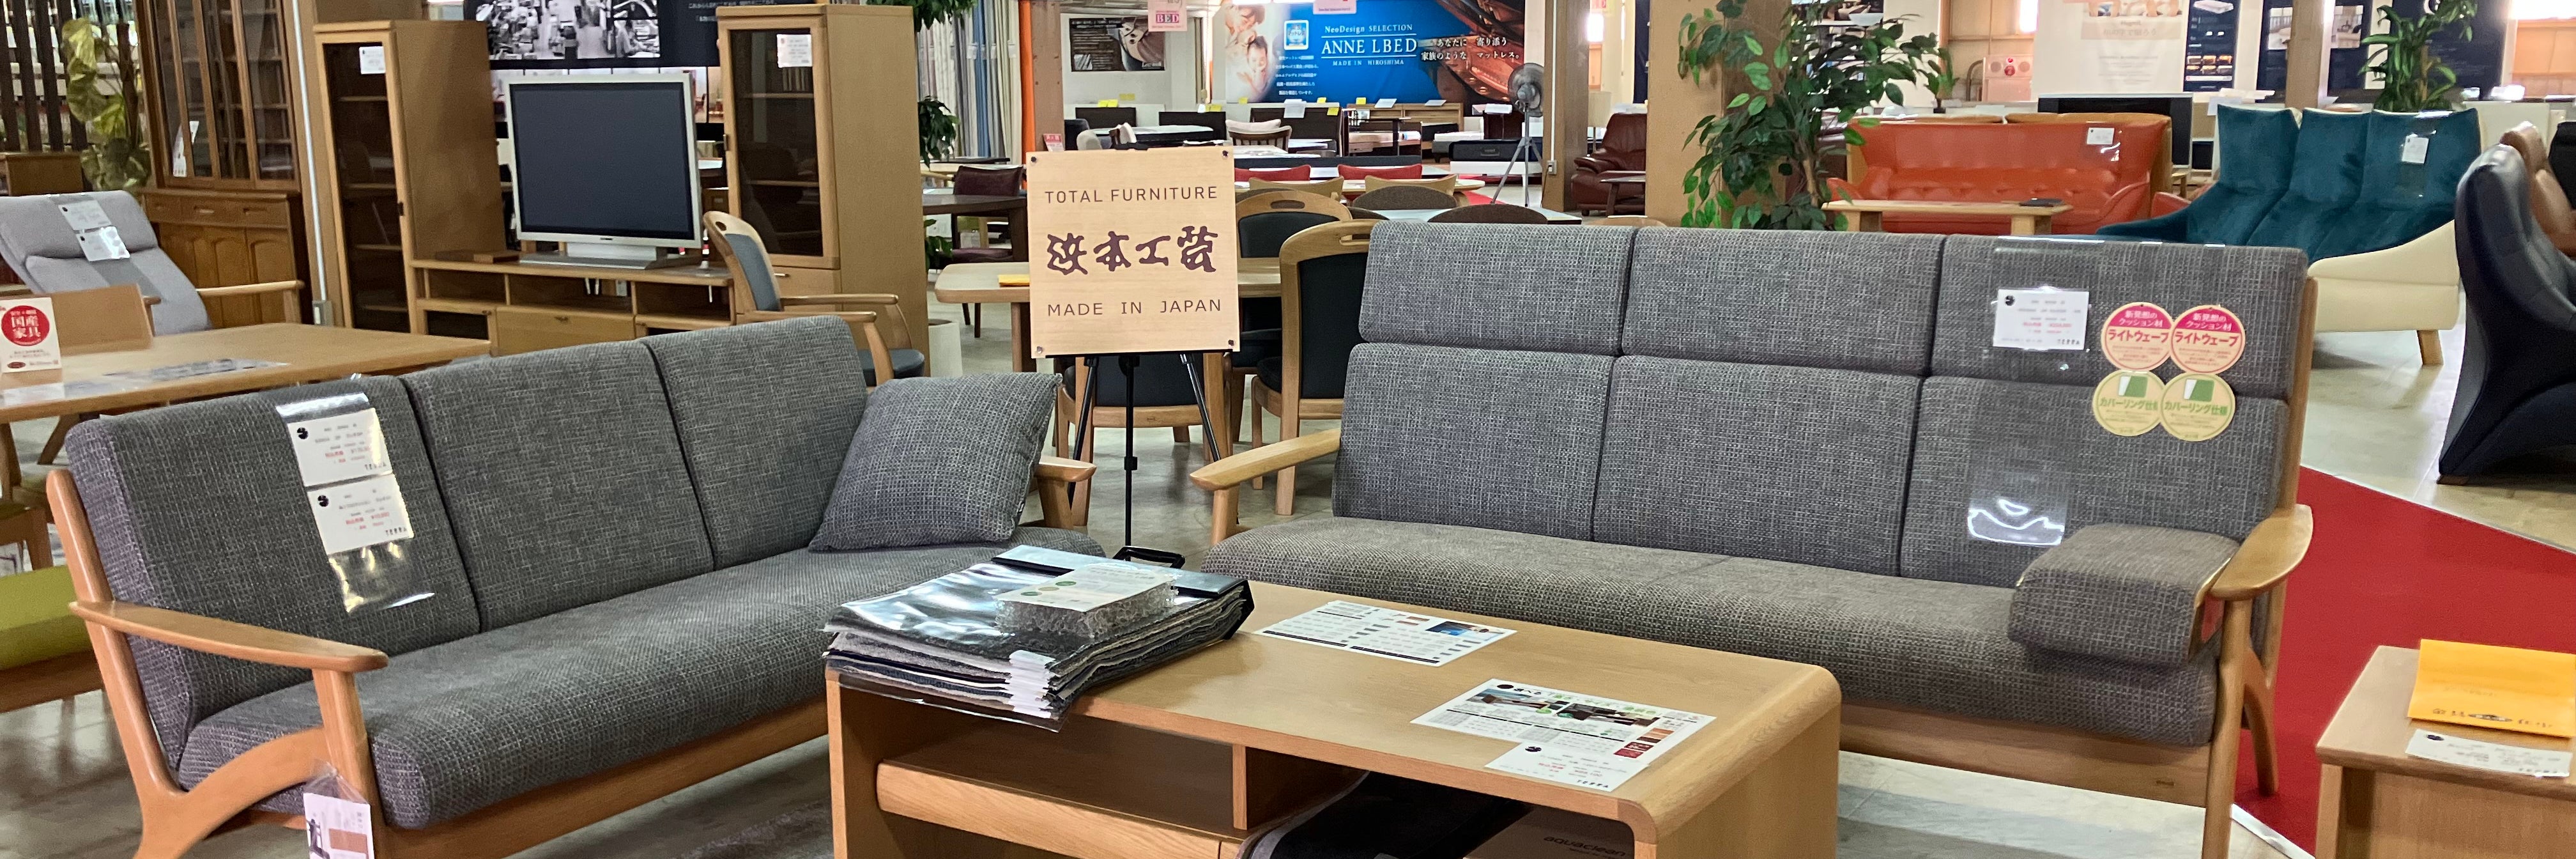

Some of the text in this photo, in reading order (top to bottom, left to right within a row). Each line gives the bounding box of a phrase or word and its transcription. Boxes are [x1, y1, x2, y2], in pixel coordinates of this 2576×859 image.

[1156, 14, 1179, 23] BED
[1324, 26, 1365, 35] NeoDesign
[1321, 38, 1417, 54] ANNE LBED
[1438, 37, 1506, 47] あなたに 寄り添う
[1421, 51, 1519, 61] 家族のような マットレス。
[1045, 186, 1217, 203] TOTAL FURNITURE
[1048, 299, 1221, 316] MADE IN JAPAN
[2125, 310, 2158, 319] 新発想の
[2193, 313, 2227, 322] 新発想の
[12, 315, 39, 327] 国産
[2119, 319, 2163, 328] クッション材
[2186, 320, 2232, 331] クッション材
[1544, 836, 1626, 856] aquaclean
